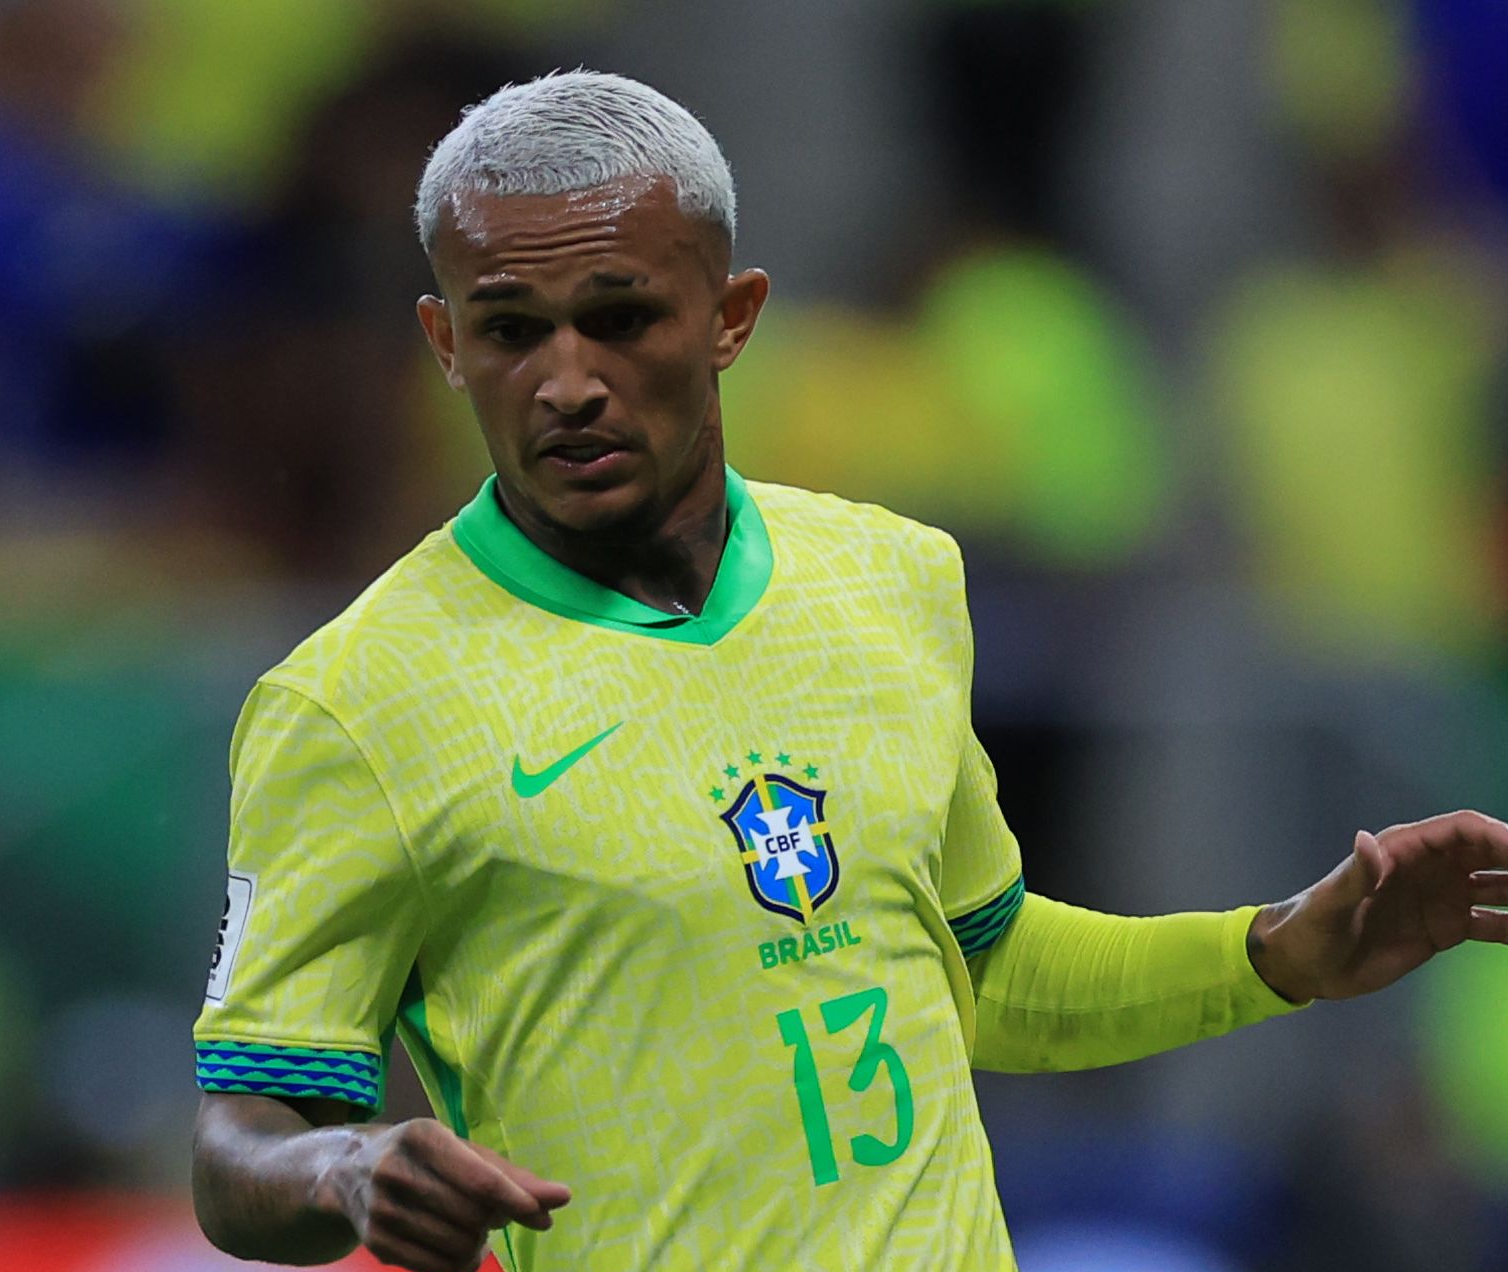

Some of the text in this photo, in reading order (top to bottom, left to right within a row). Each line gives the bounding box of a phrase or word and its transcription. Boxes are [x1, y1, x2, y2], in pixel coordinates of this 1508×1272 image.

[765, 831, 802, 854] CBF
[758, 921, 862, 970] BRASIL
[776, 986, 914, 1187] 13
